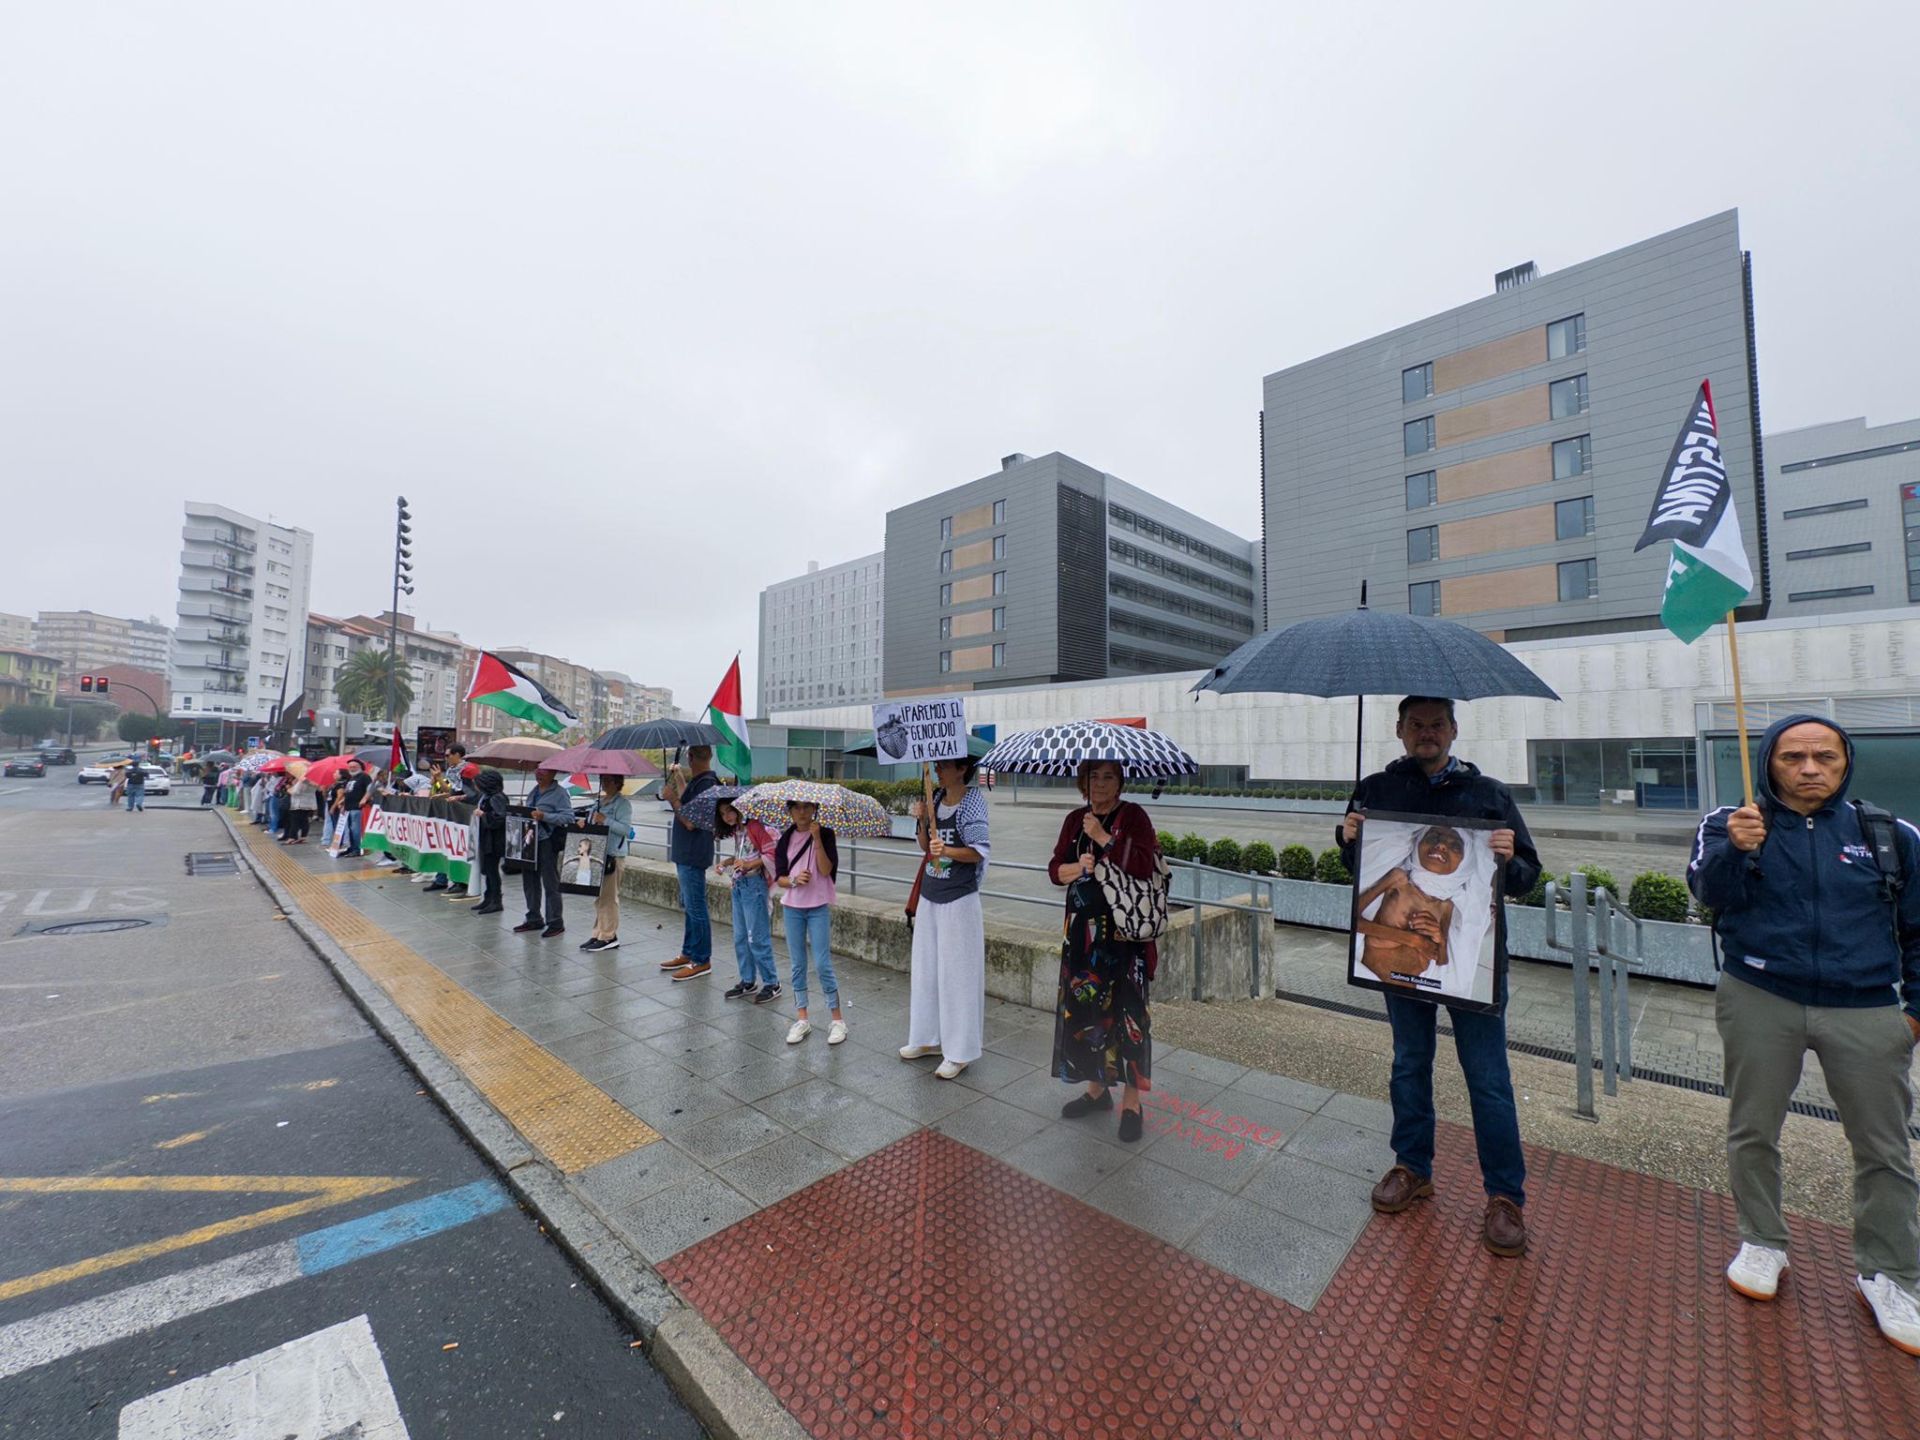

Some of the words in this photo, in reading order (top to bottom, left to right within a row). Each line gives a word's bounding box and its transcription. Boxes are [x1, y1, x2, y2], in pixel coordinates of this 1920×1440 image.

[950, 702, 963, 718] EL
[910, 721, 956, 740] GENOCIDIO
[912, 744, 924, 759] EN
[928, 740, 958, 758] GAZA!
[0, 886, 171, 916] US
